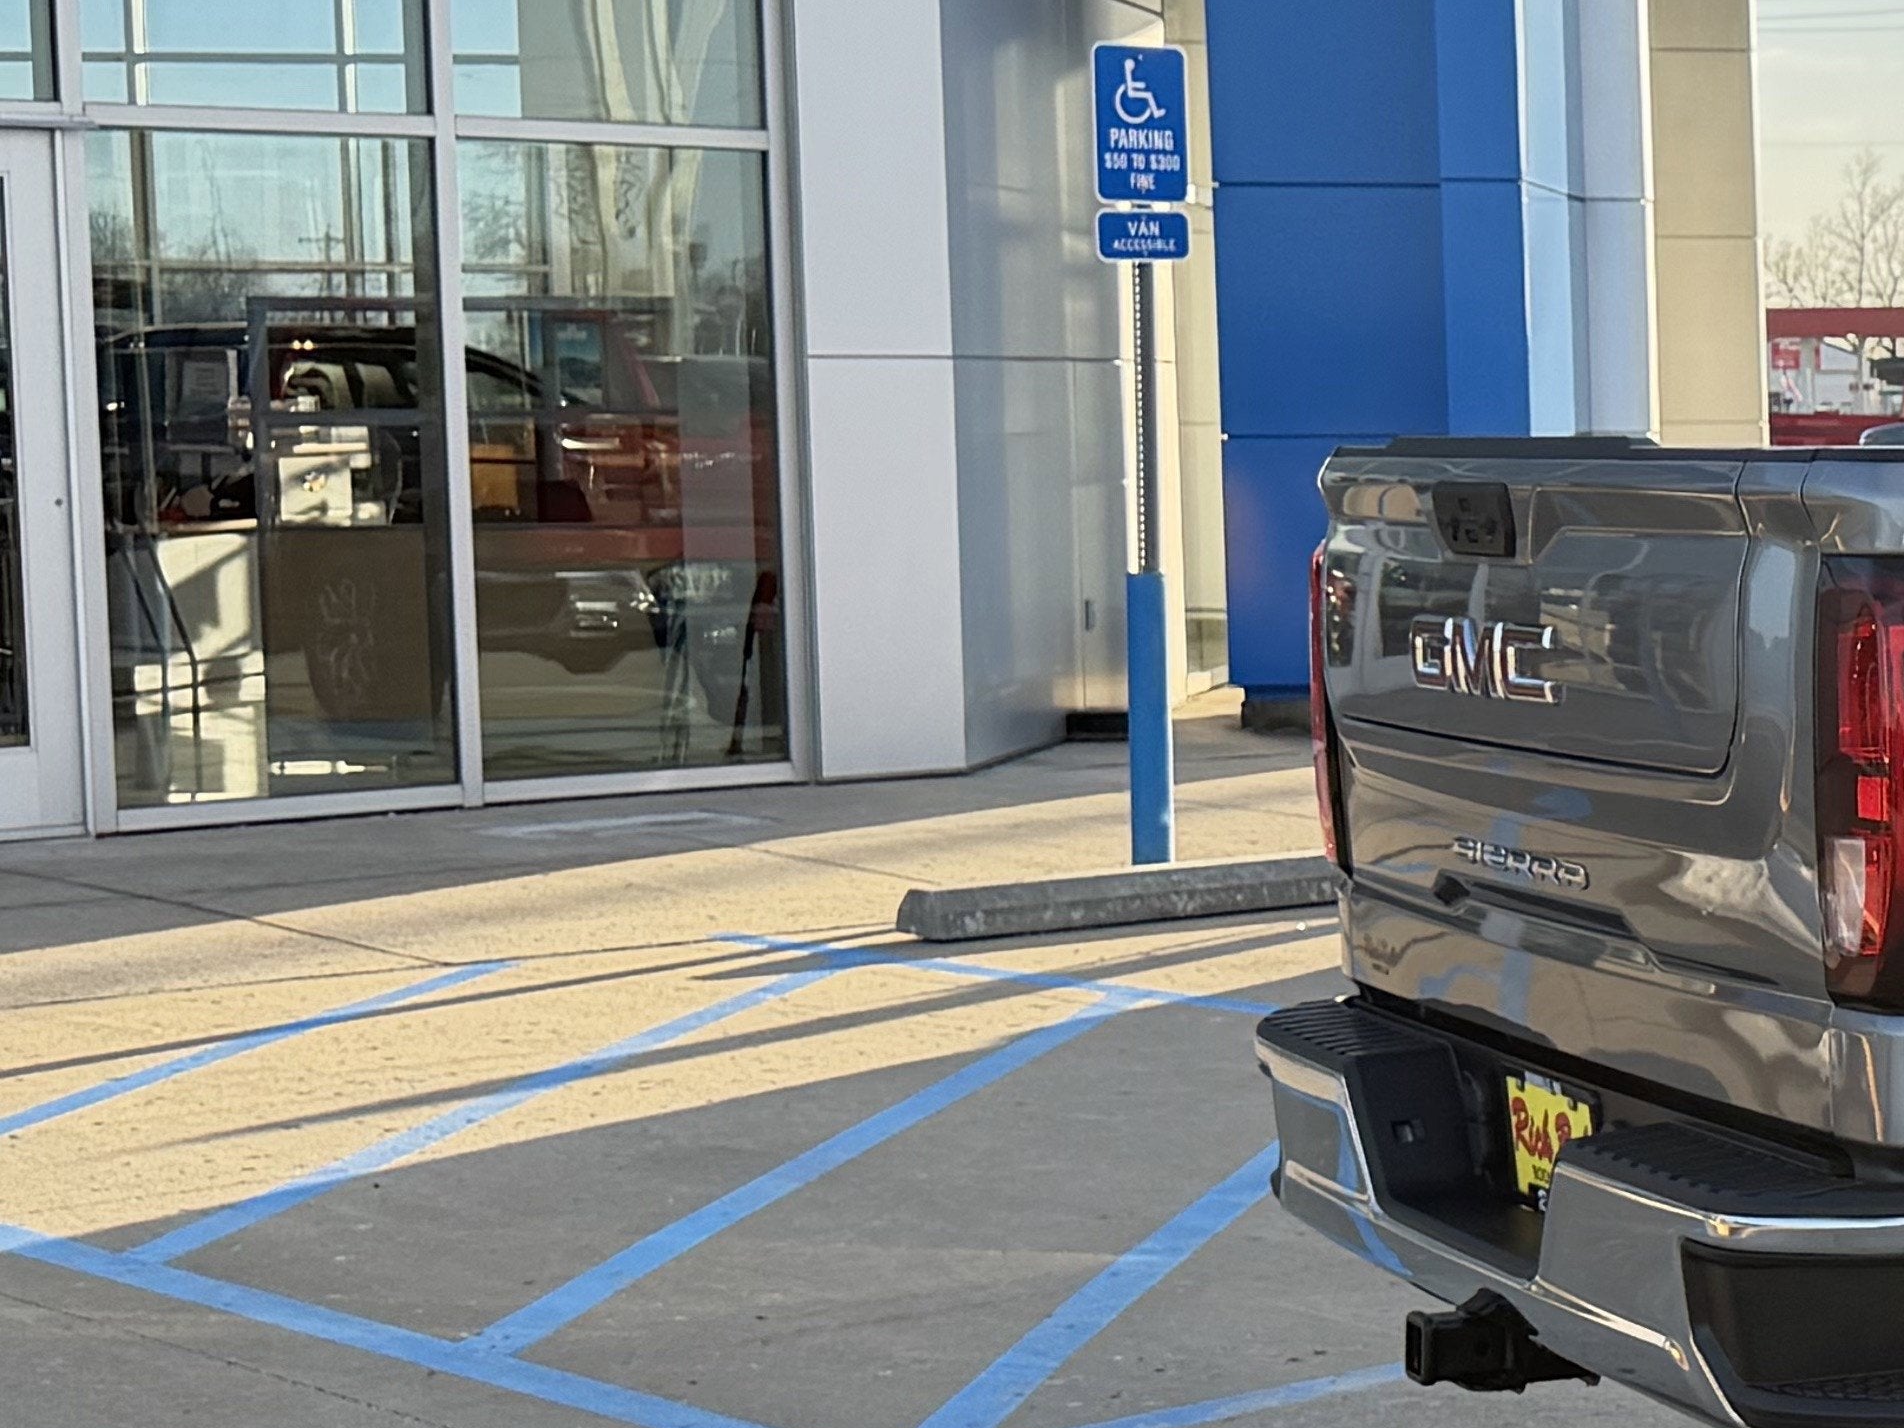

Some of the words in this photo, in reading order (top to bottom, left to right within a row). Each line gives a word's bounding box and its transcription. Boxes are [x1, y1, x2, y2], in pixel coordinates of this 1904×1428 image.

[1109, 128, 1175, 151] PARKING
[1104, 152, 1128, 169] $50
[1131, 153, 1146, 170] TO
[1149, 153, 1181, 171] $300
[1129, 172, 1156, 191] FINE
[1127, 221, 1161, 237] VAN
[1113, 238, 1176, 252] ACCESSIBLE
[1409, 614, 1564, 705] GMC
[1452, 834, 1591, 891] SIERRA
